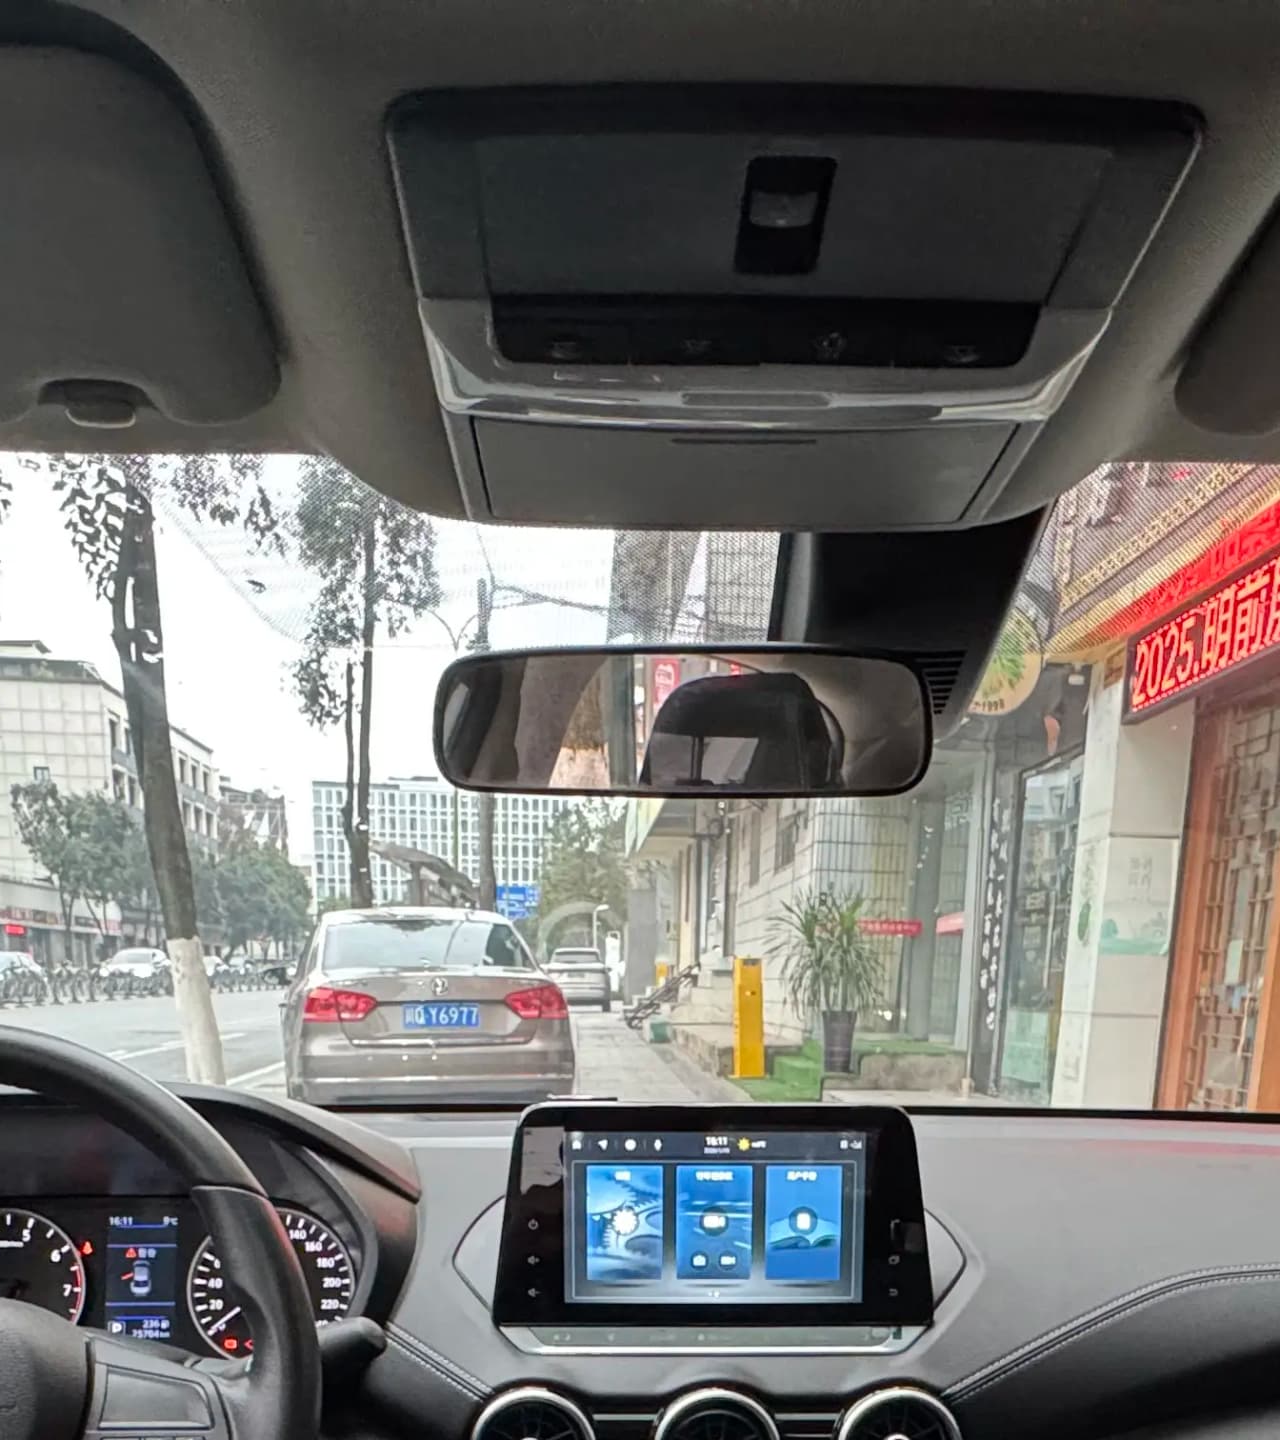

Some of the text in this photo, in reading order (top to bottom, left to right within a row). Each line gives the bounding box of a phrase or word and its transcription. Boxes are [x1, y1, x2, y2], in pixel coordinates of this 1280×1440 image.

[22, 1229, 31, 1242] 5
[289, 1230, 307, 1240] 140
[51, 1250, 61, 1263] 6
[208, 1277, 223, 1289] 40
[323, 1277, 341, 1288] 200
[63, 1284, 72, 1297] 7
